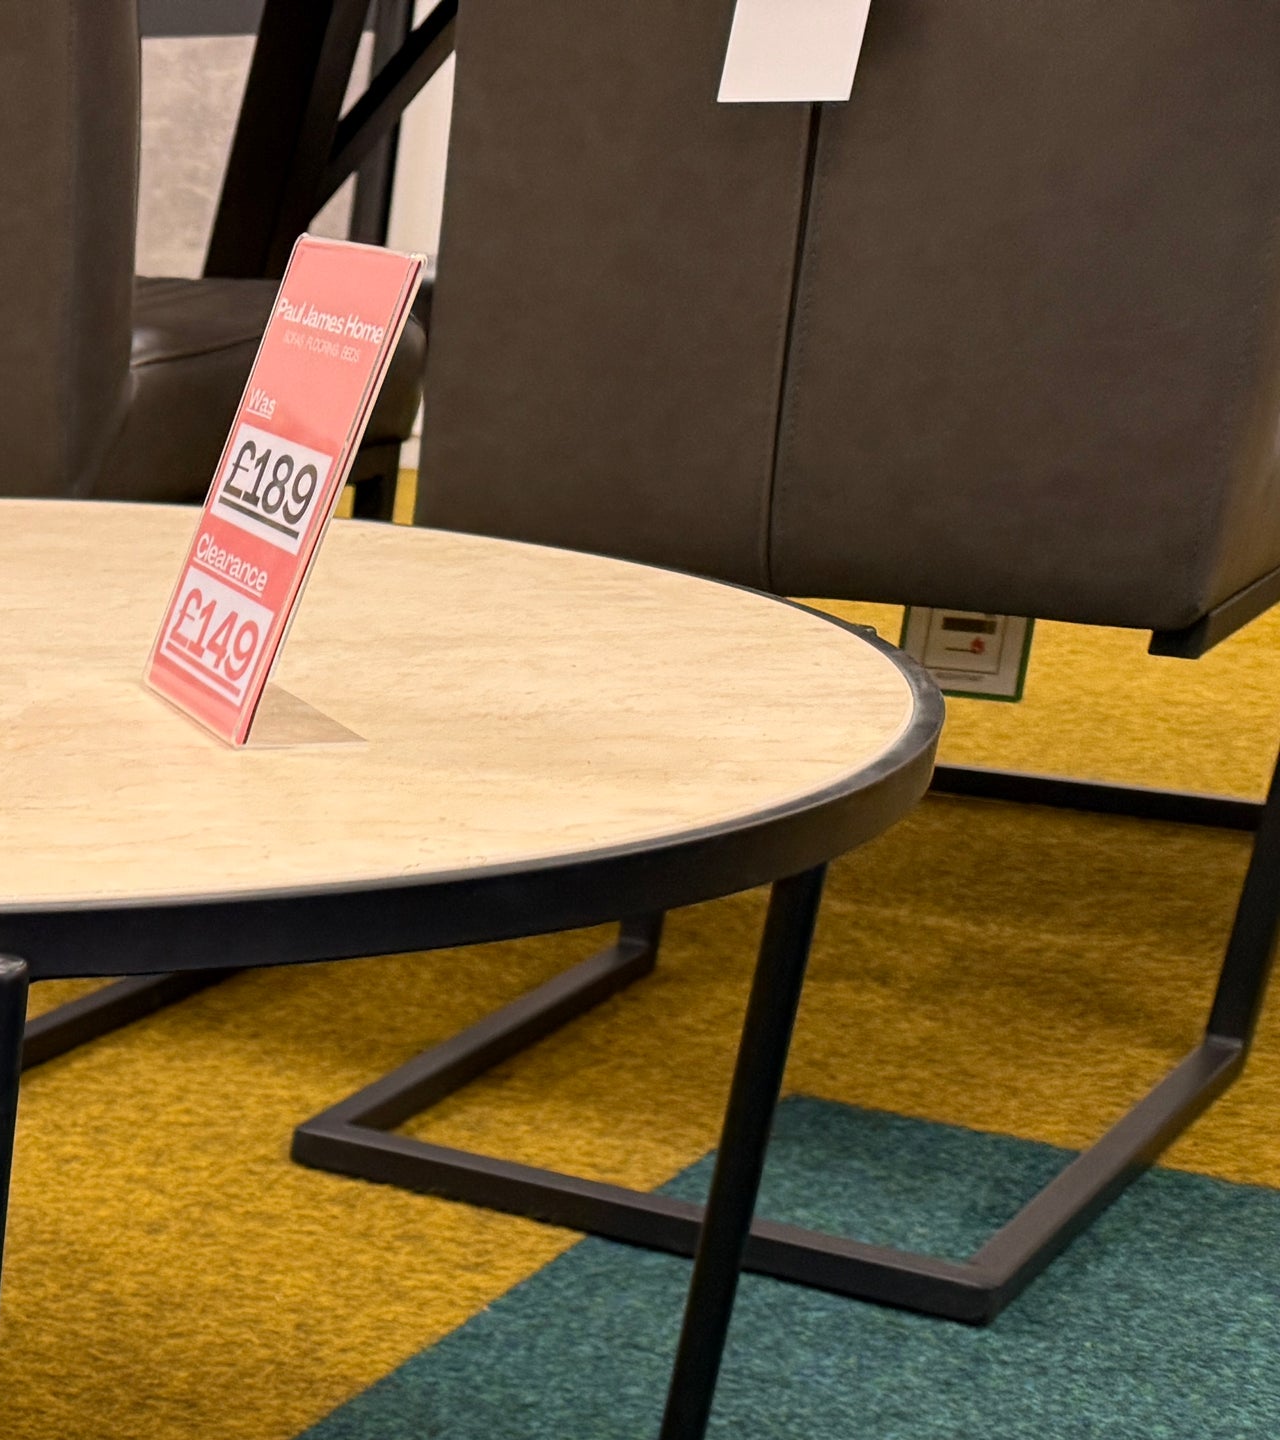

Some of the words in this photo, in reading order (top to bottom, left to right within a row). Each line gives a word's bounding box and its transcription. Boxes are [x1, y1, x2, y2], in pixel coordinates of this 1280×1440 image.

[276, 298, 306, 322] Paul
[303, 304, 344, 334] James
[343, 314, 384, 344] Home
[248, 388, 276, 415] Was
[223, 440, 318, 525] £189
[196, 532, 268, 591] Clearance
[169, 588, 259, 681] £149
